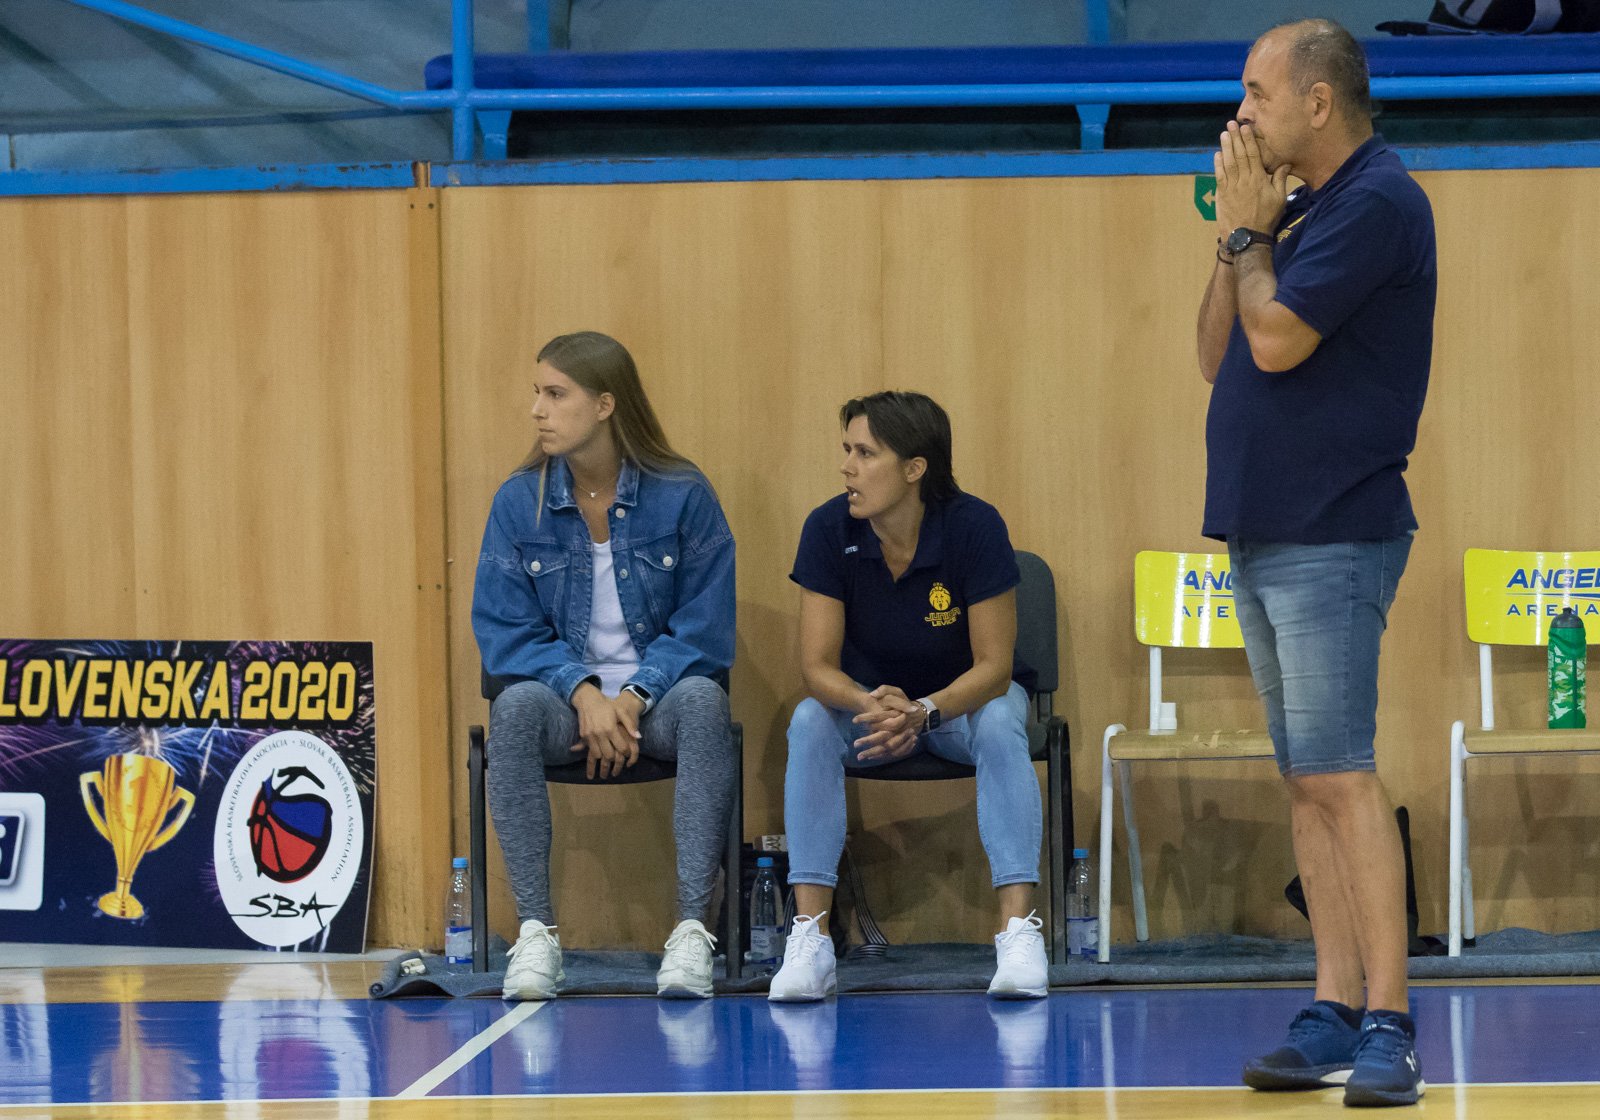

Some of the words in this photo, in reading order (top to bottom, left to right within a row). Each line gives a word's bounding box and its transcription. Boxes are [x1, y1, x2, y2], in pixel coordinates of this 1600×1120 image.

[0, 659, 230, 719] LOVENSKA
[240, 661, 357, 721] 2020
[299, 739, 326, 758] SLOVAK
[327, 756, 353, 810] BASKETBALL
[331, 815, 354, 882] ASSOCIATION
[230, 891, 339, 930] SBA
